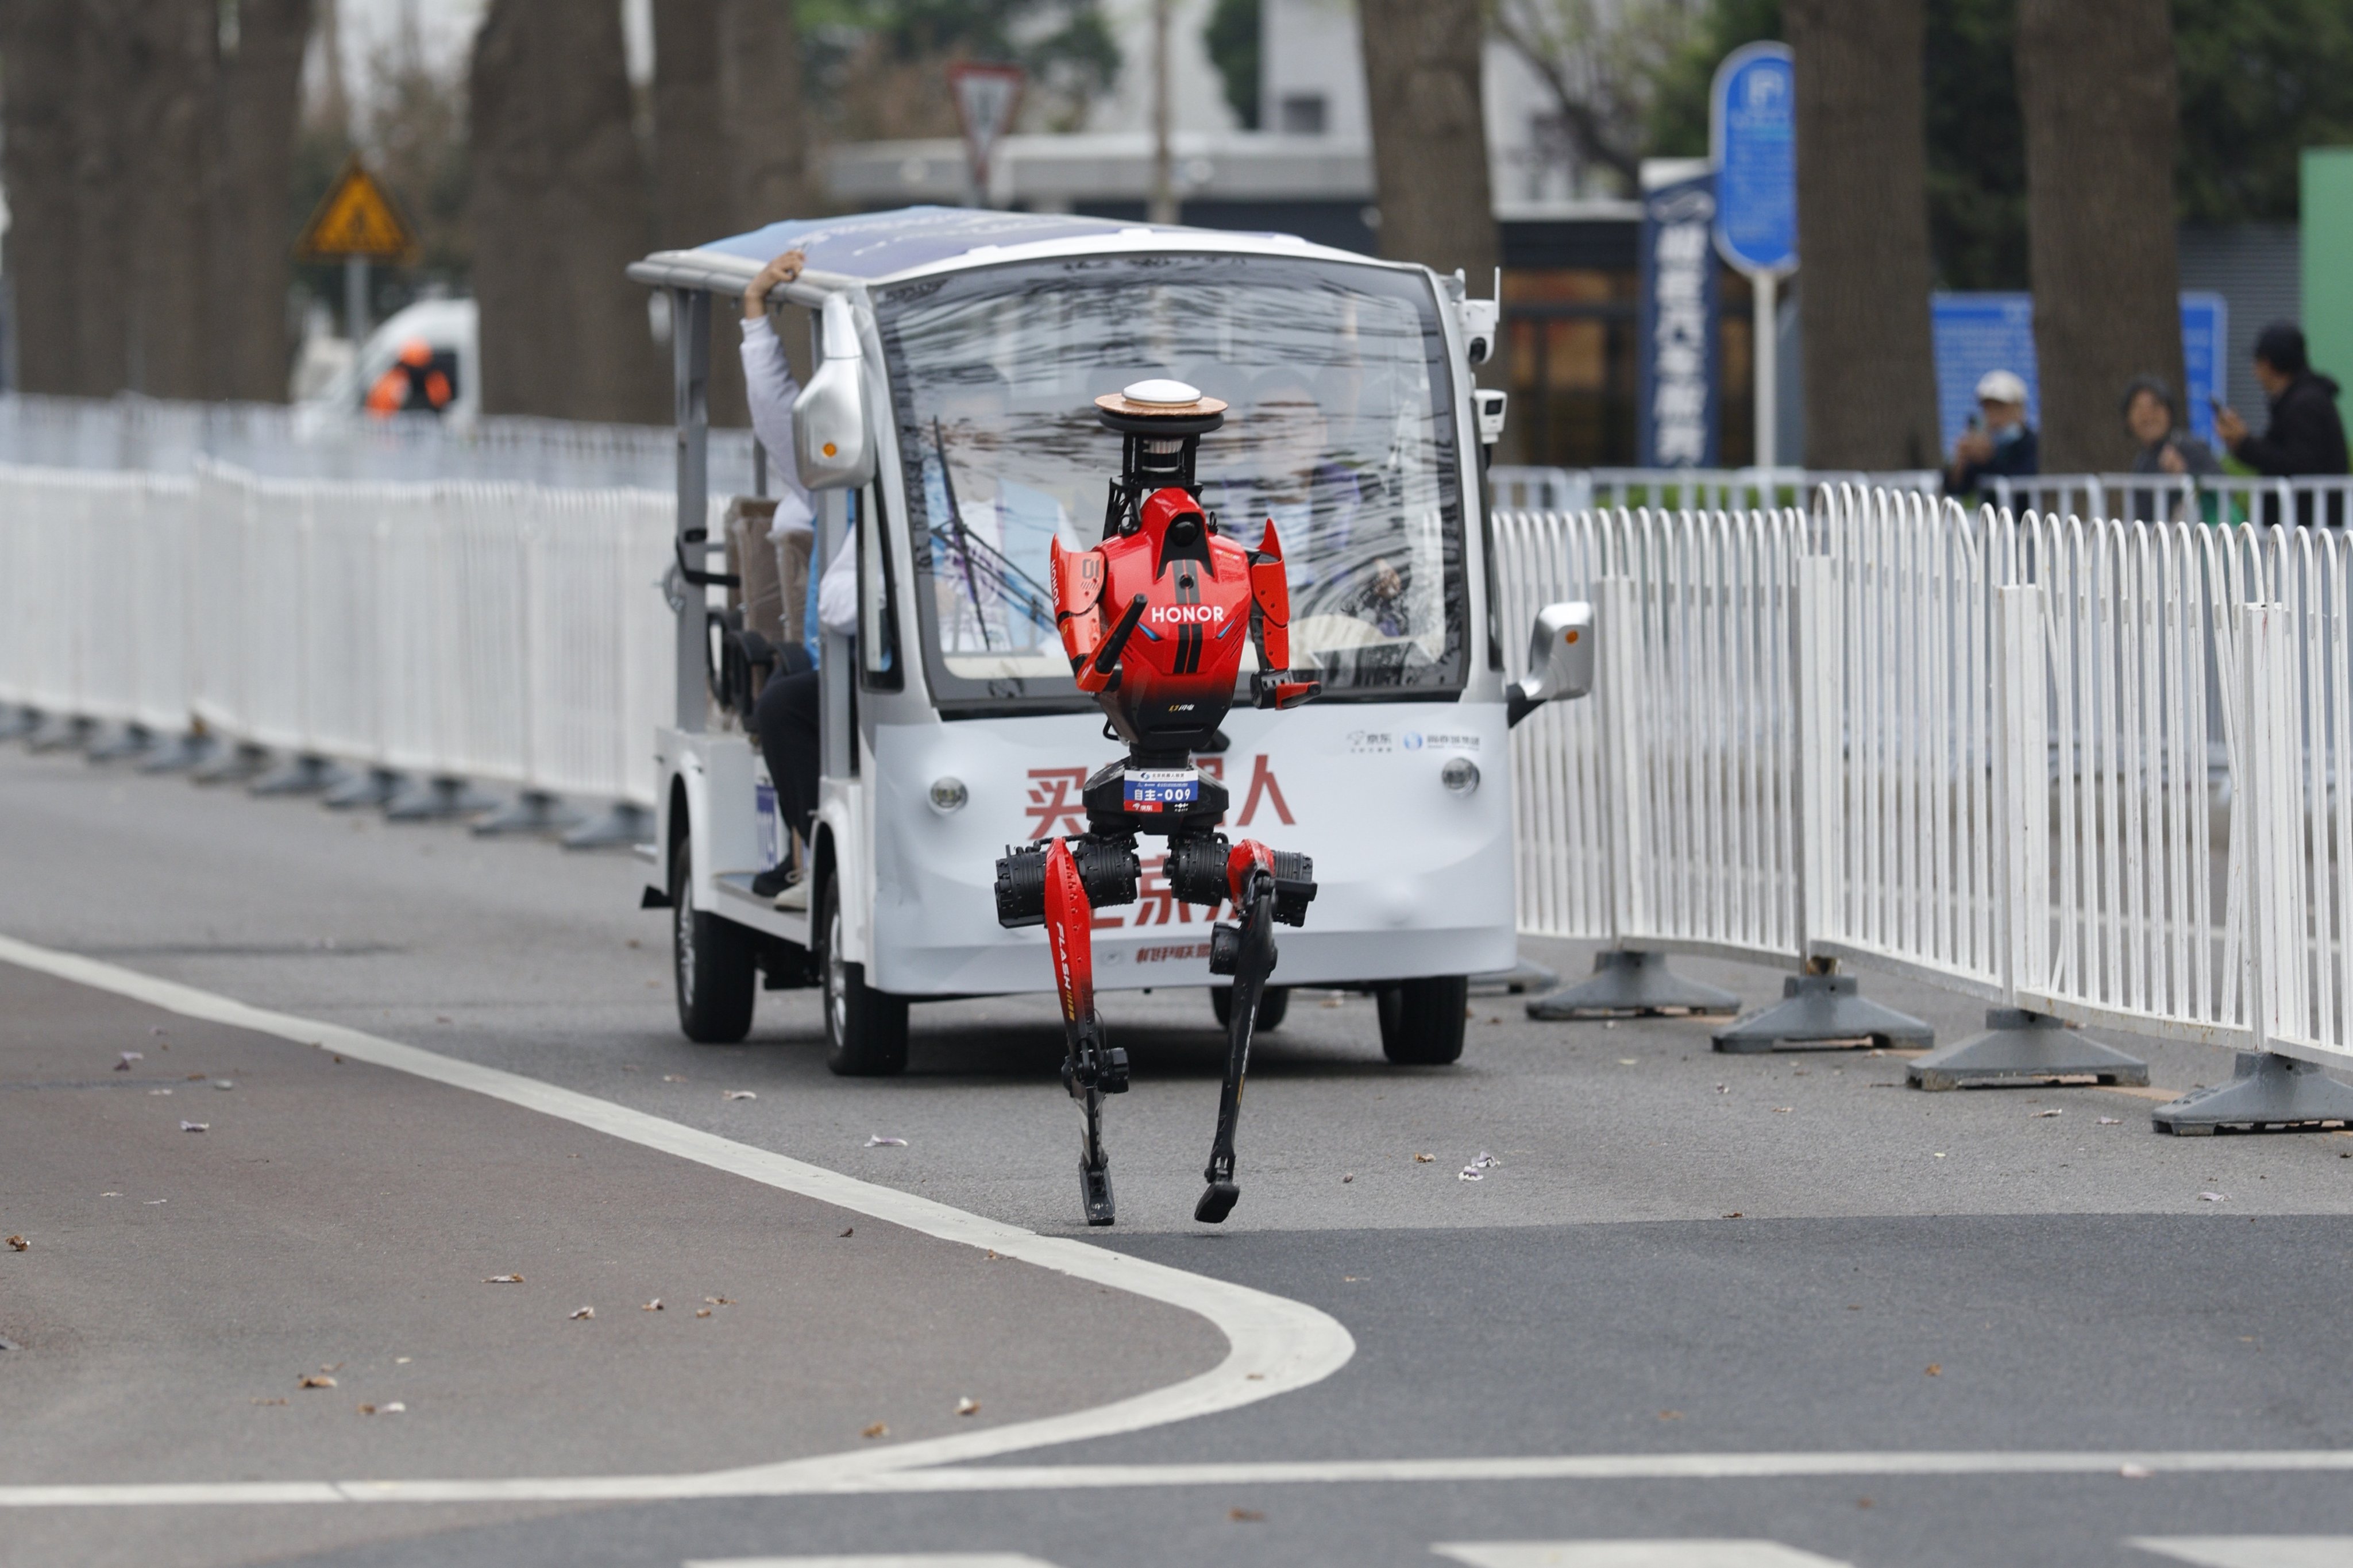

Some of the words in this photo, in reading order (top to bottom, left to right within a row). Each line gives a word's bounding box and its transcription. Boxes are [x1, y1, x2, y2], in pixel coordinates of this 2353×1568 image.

[1051, 559, 1060, 608] HONOR
[1082, 558, 1100, 579] 01
[1151, 606, 1224, 623] HONOR
[1026, 754, 1296, 840] 买人
[1134, 788, 1191, 801] 自主-009
[1056, 921, 1071, 990] FLASH
